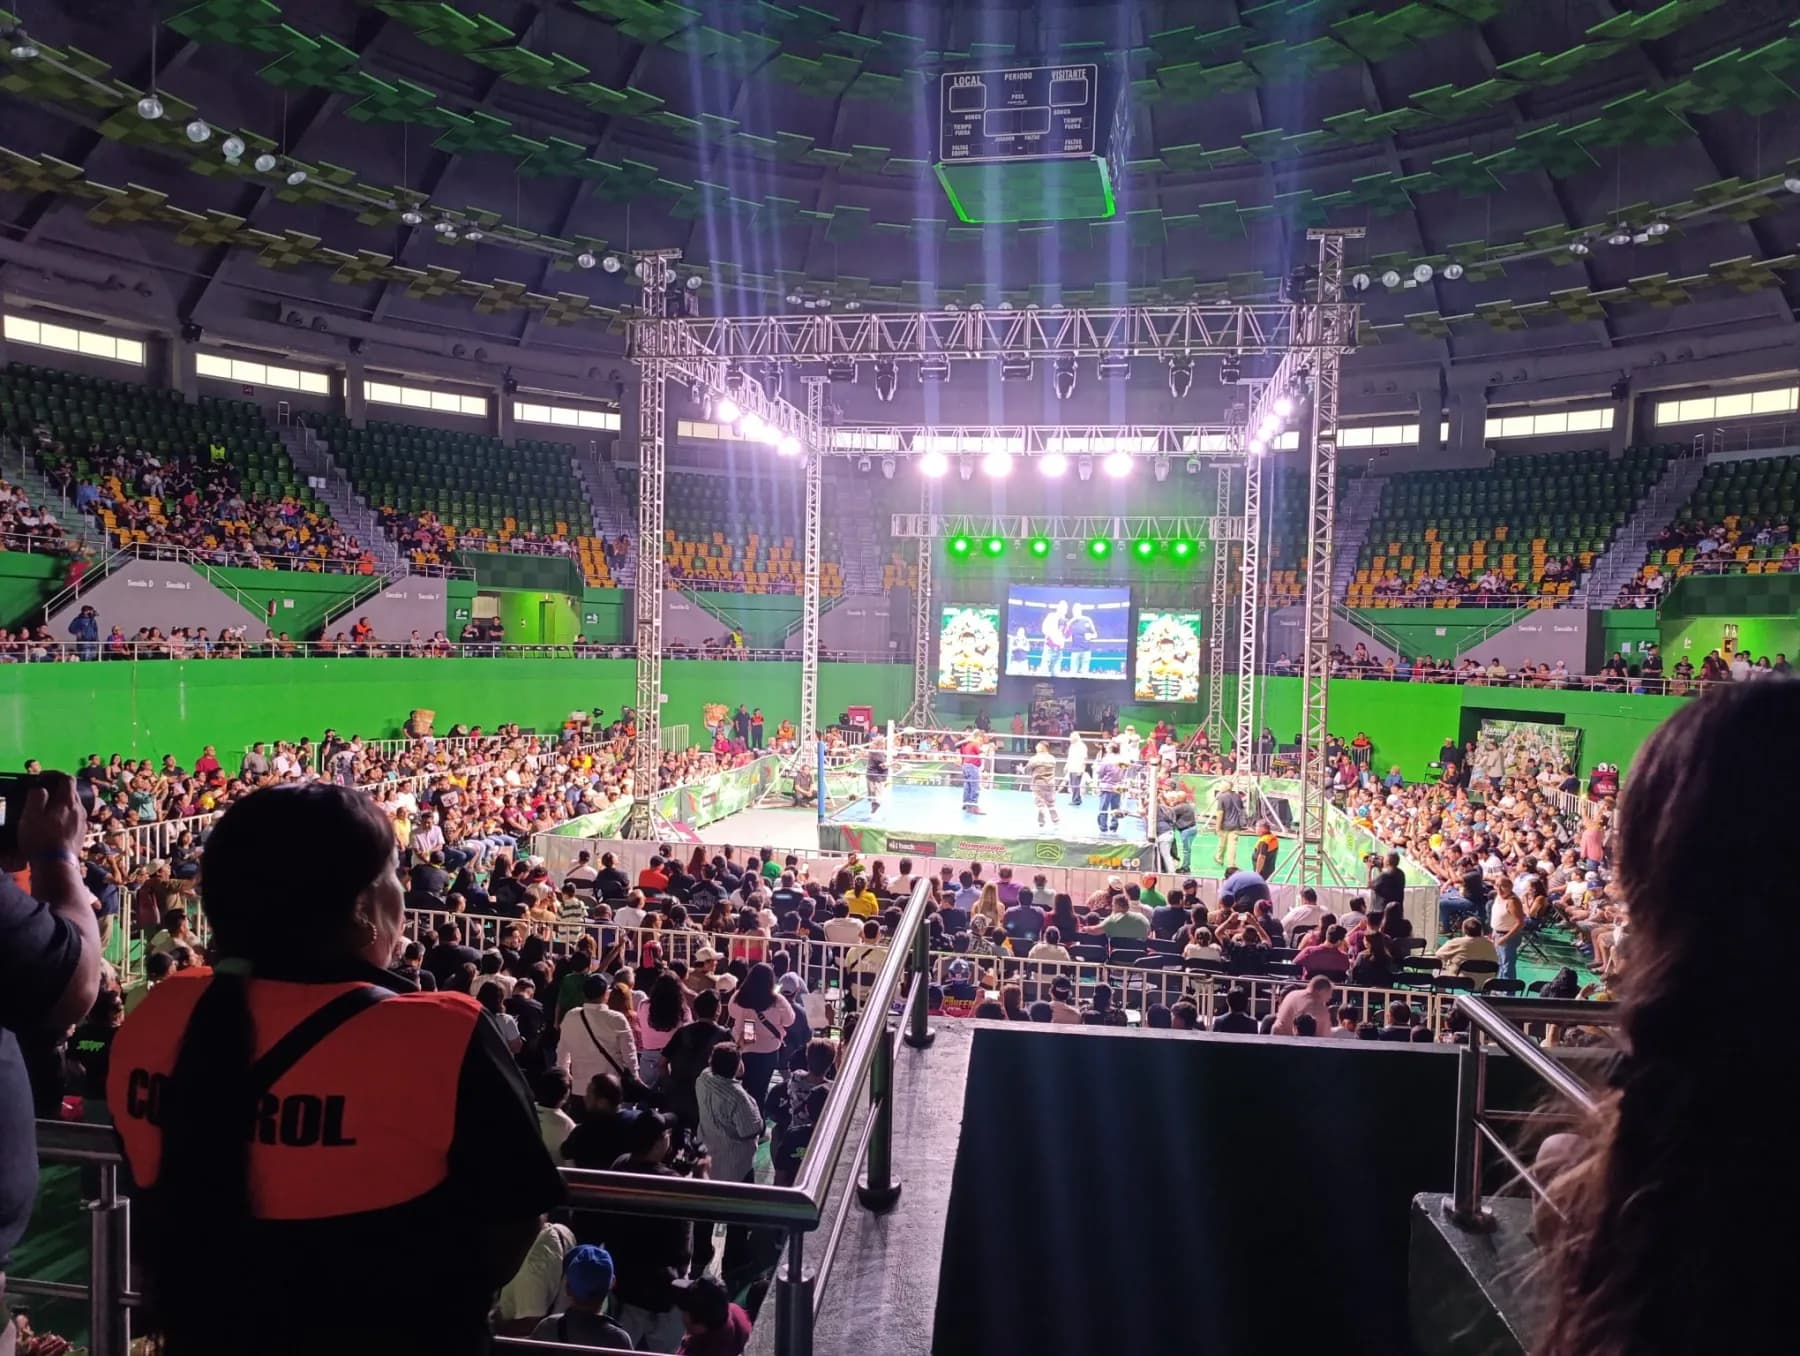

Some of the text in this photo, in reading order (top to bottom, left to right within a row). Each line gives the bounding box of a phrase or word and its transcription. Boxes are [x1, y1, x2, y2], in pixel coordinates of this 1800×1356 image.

[1004, 72, 1033, 80] PERIODO
[1051, 68, 1087, 80] VISITANTE
[953, 75, 982, 87] LOCAL
[126, 1068, 357, 1147] COROL
